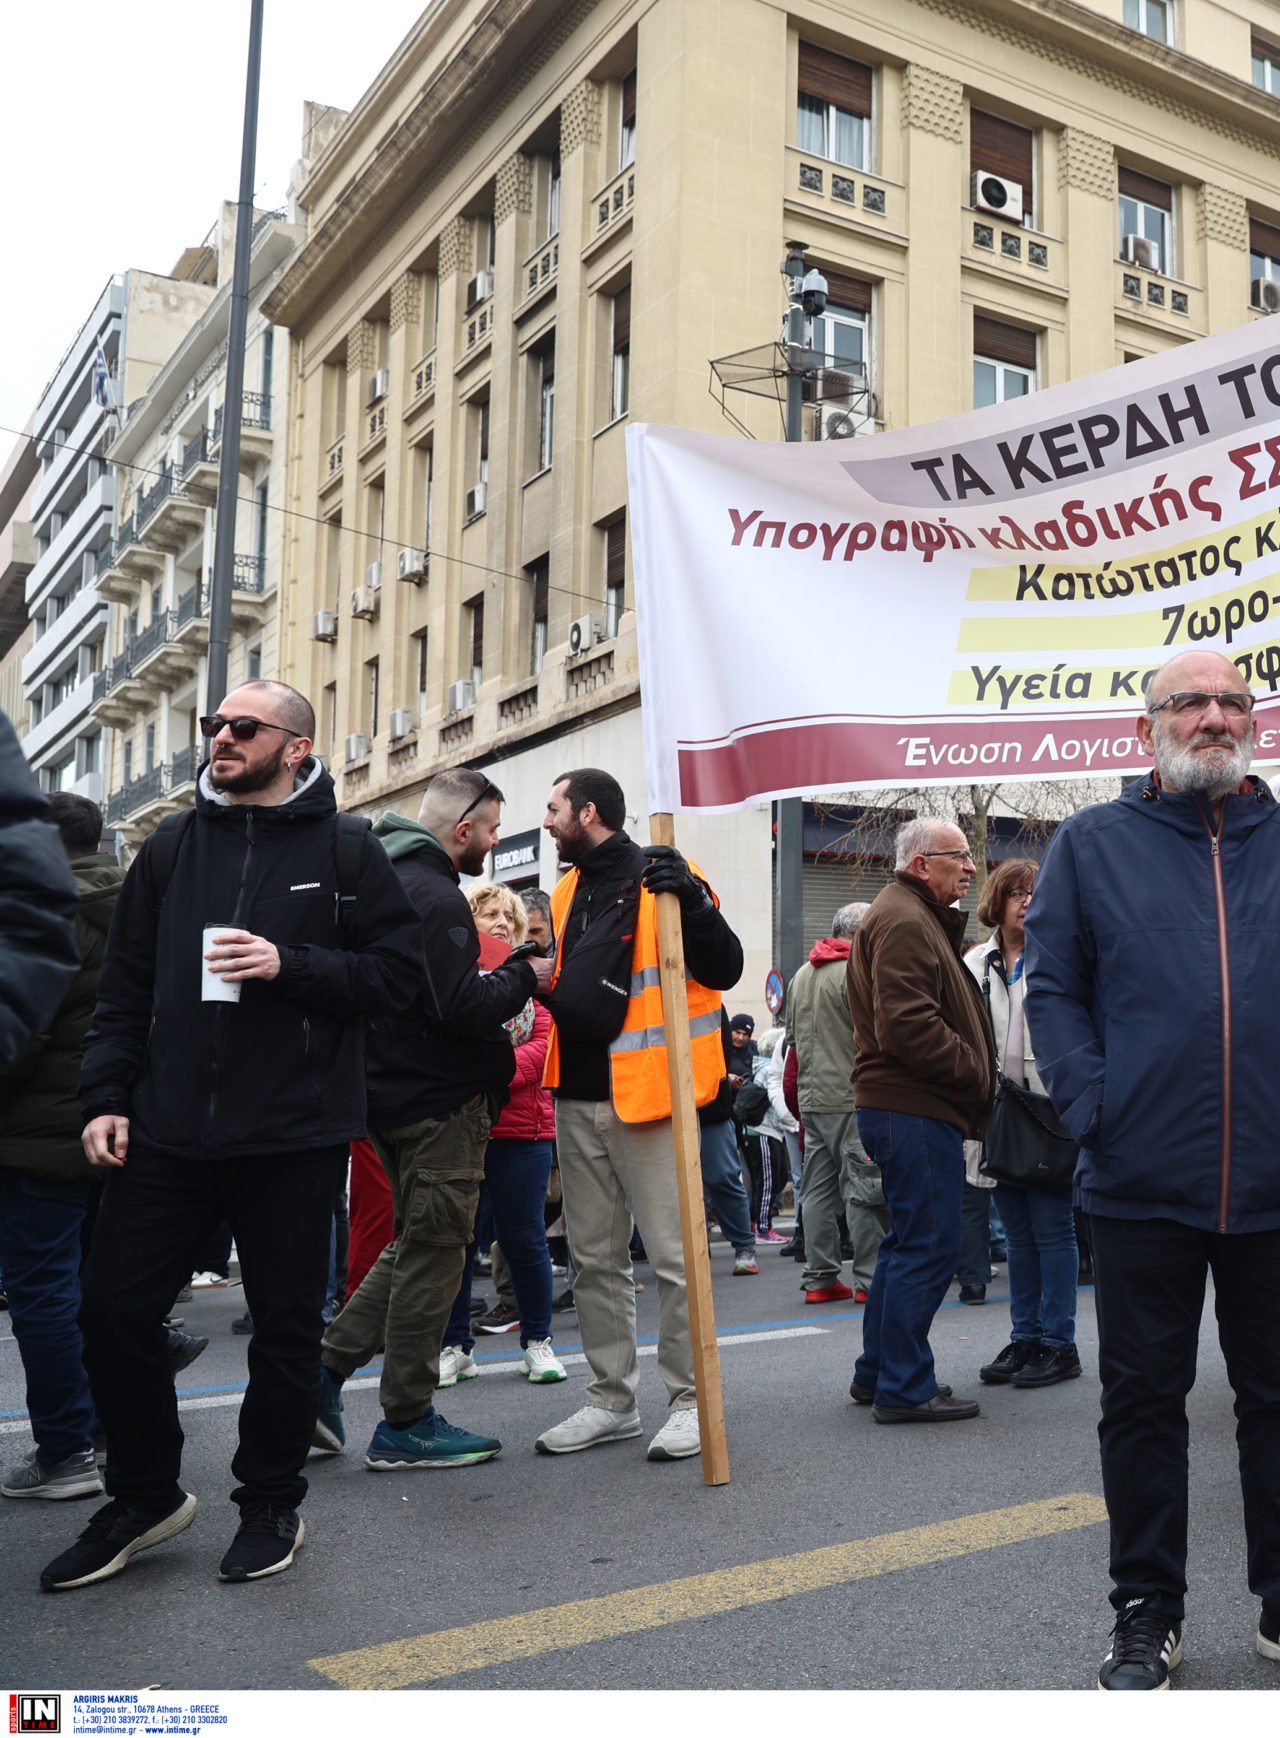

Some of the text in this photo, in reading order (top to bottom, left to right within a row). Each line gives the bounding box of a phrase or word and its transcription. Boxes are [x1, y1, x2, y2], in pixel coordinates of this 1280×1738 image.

[911, 453, 995, 501] ΤΑ
[998, 384, 1210, 490] ΚΕΡΔΗ
[728, 508, 976, 562] Υπογραφή
[978, 473, 1222, 551] κλαδικής
[1016, 533, 1242, 602] Κατώτατος
[970, 663, 1092, 710] Υγεία
[896, 736, 1022, 766] Ένωση
[1031, 733, 1145, 766] Λογιστ
[494, 845, 535, 870] EUROBANK
[290, 882, 320, 891] EMERSON
